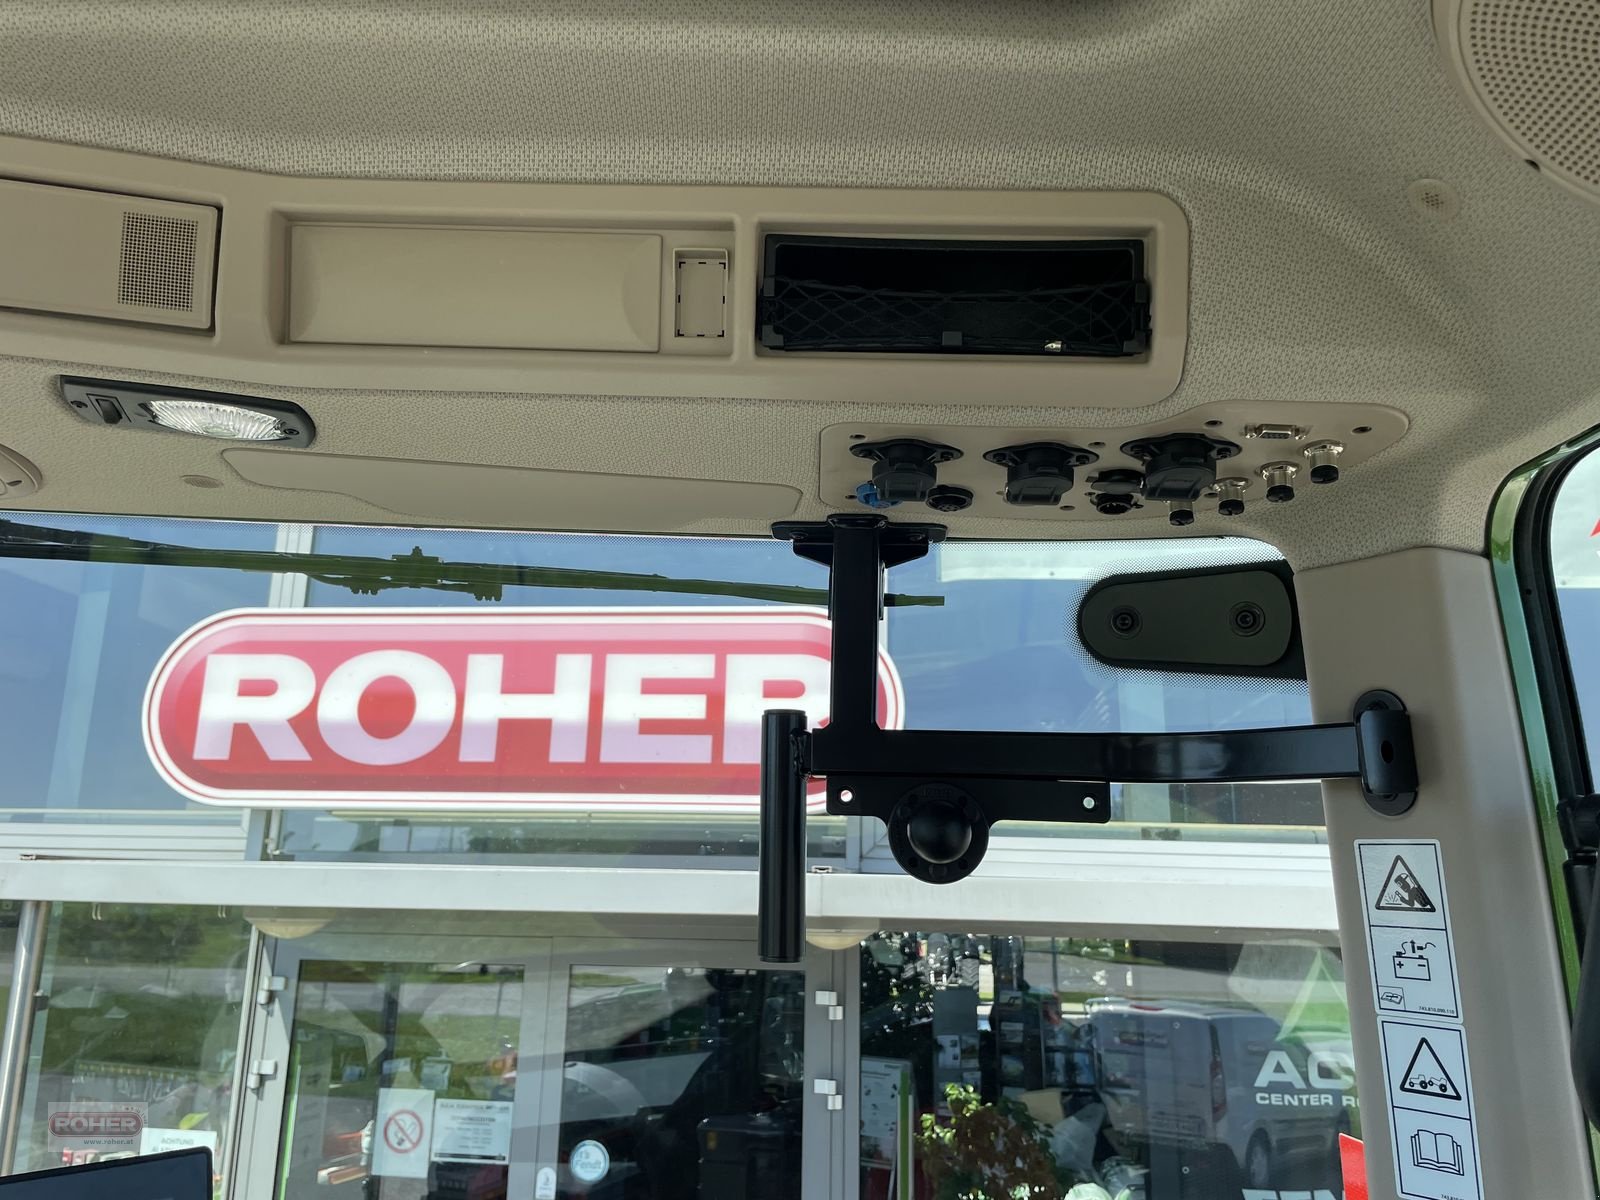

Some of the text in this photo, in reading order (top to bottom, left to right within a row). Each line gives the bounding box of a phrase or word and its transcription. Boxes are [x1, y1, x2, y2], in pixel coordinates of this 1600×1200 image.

[193, 649, 832, 766] ROHER
[1255, 1092, 1360, 1107] CENTER R
